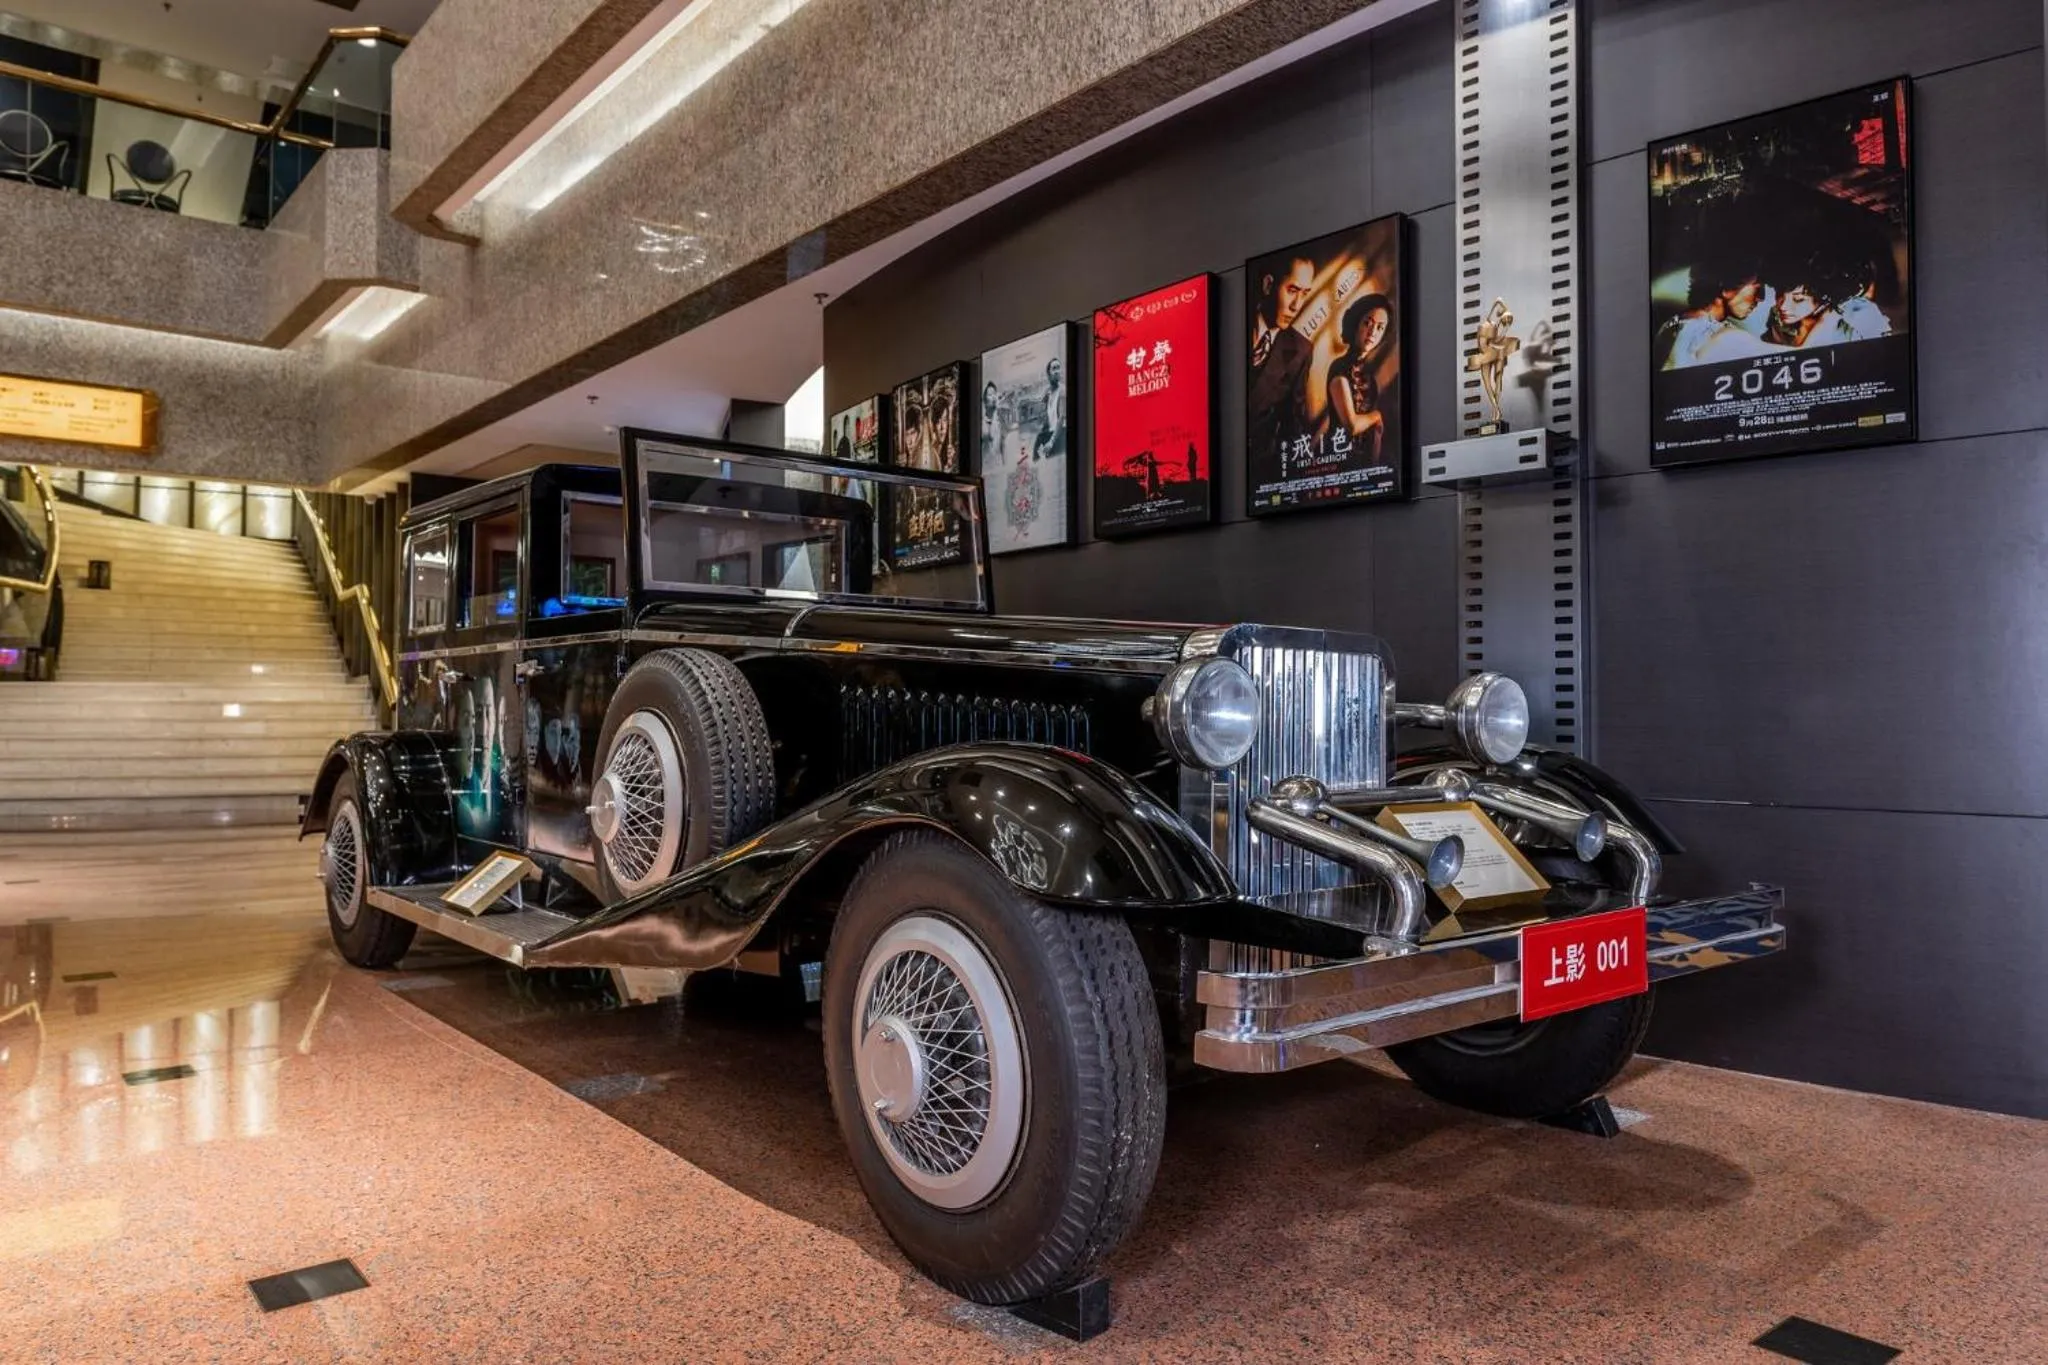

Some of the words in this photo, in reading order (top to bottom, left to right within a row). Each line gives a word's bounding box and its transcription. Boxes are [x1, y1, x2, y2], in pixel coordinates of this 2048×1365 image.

[1128, 377, 1170, 397] MELODY
[1714, 358, 1821, 400] 2046
[1544, 942, 1586, 987] 上影
[1597, 936, 1628, 972] 001
